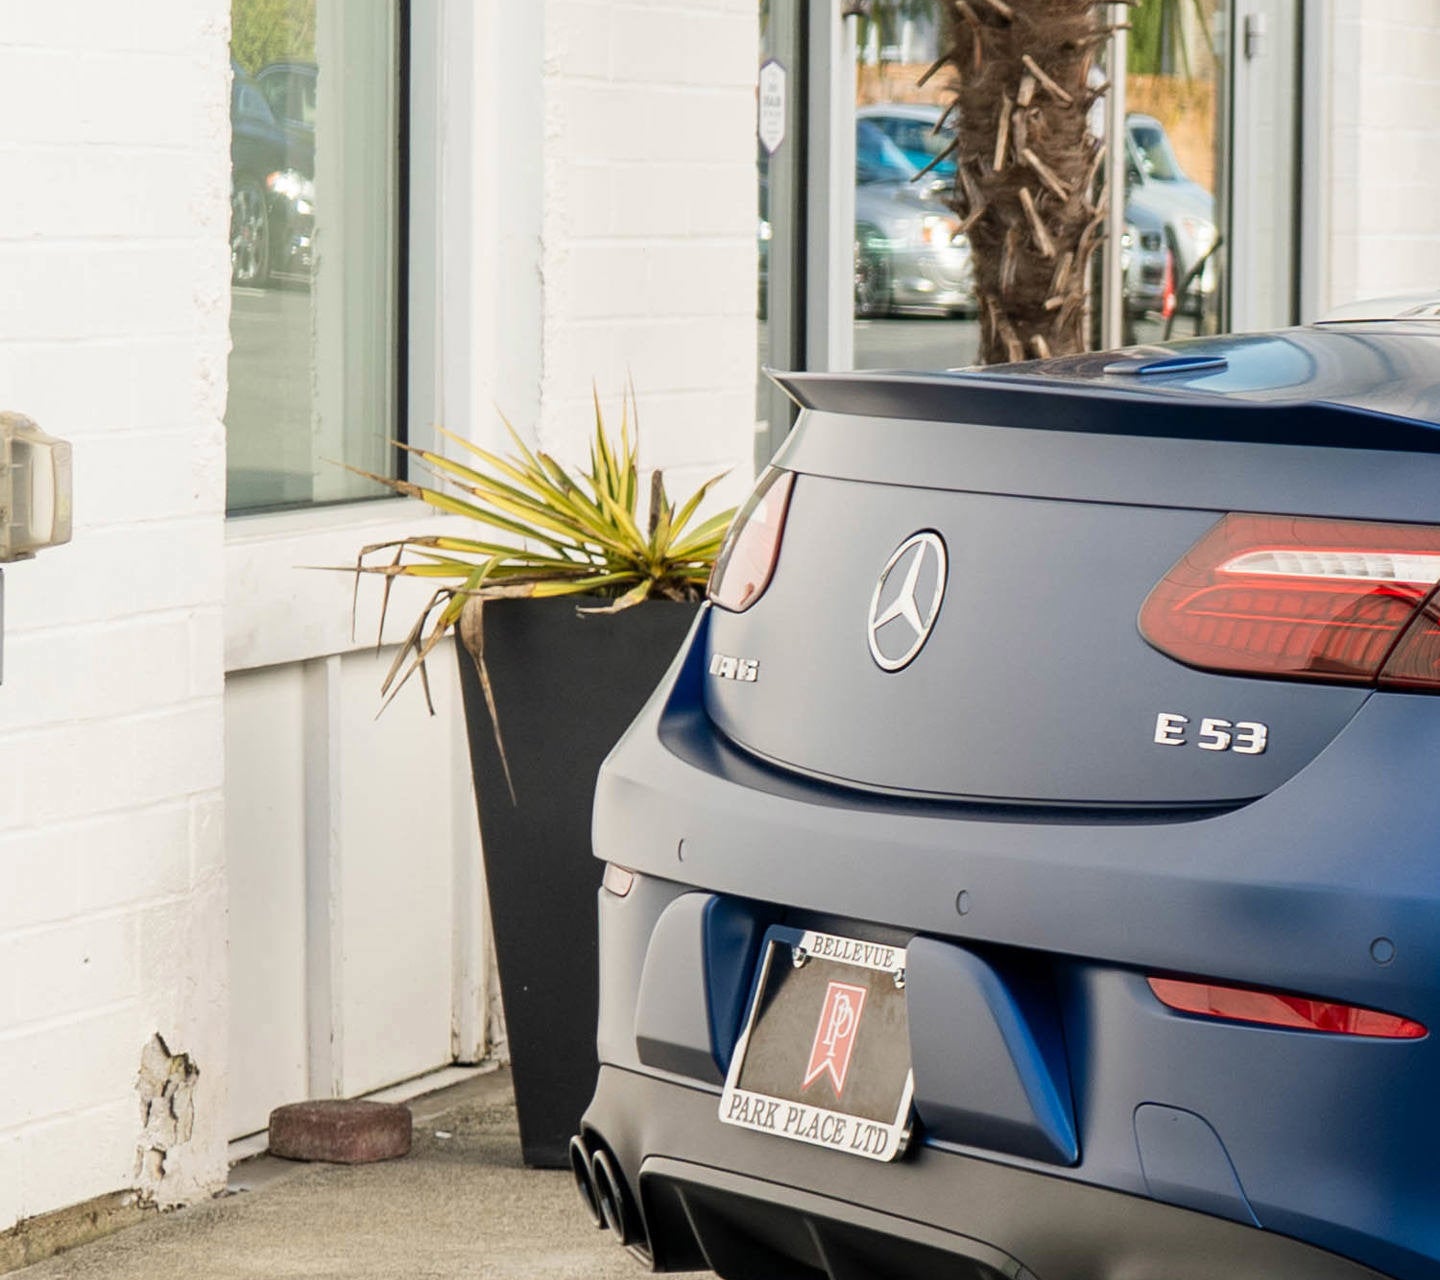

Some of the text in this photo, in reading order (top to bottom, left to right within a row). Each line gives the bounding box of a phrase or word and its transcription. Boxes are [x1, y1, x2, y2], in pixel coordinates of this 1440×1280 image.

[1154, 712, 1268, 754] E 53
[812, 935, 895, 968] BELLEVUE
[727, 1094, 888, 1155] PARK PLACE LTD
